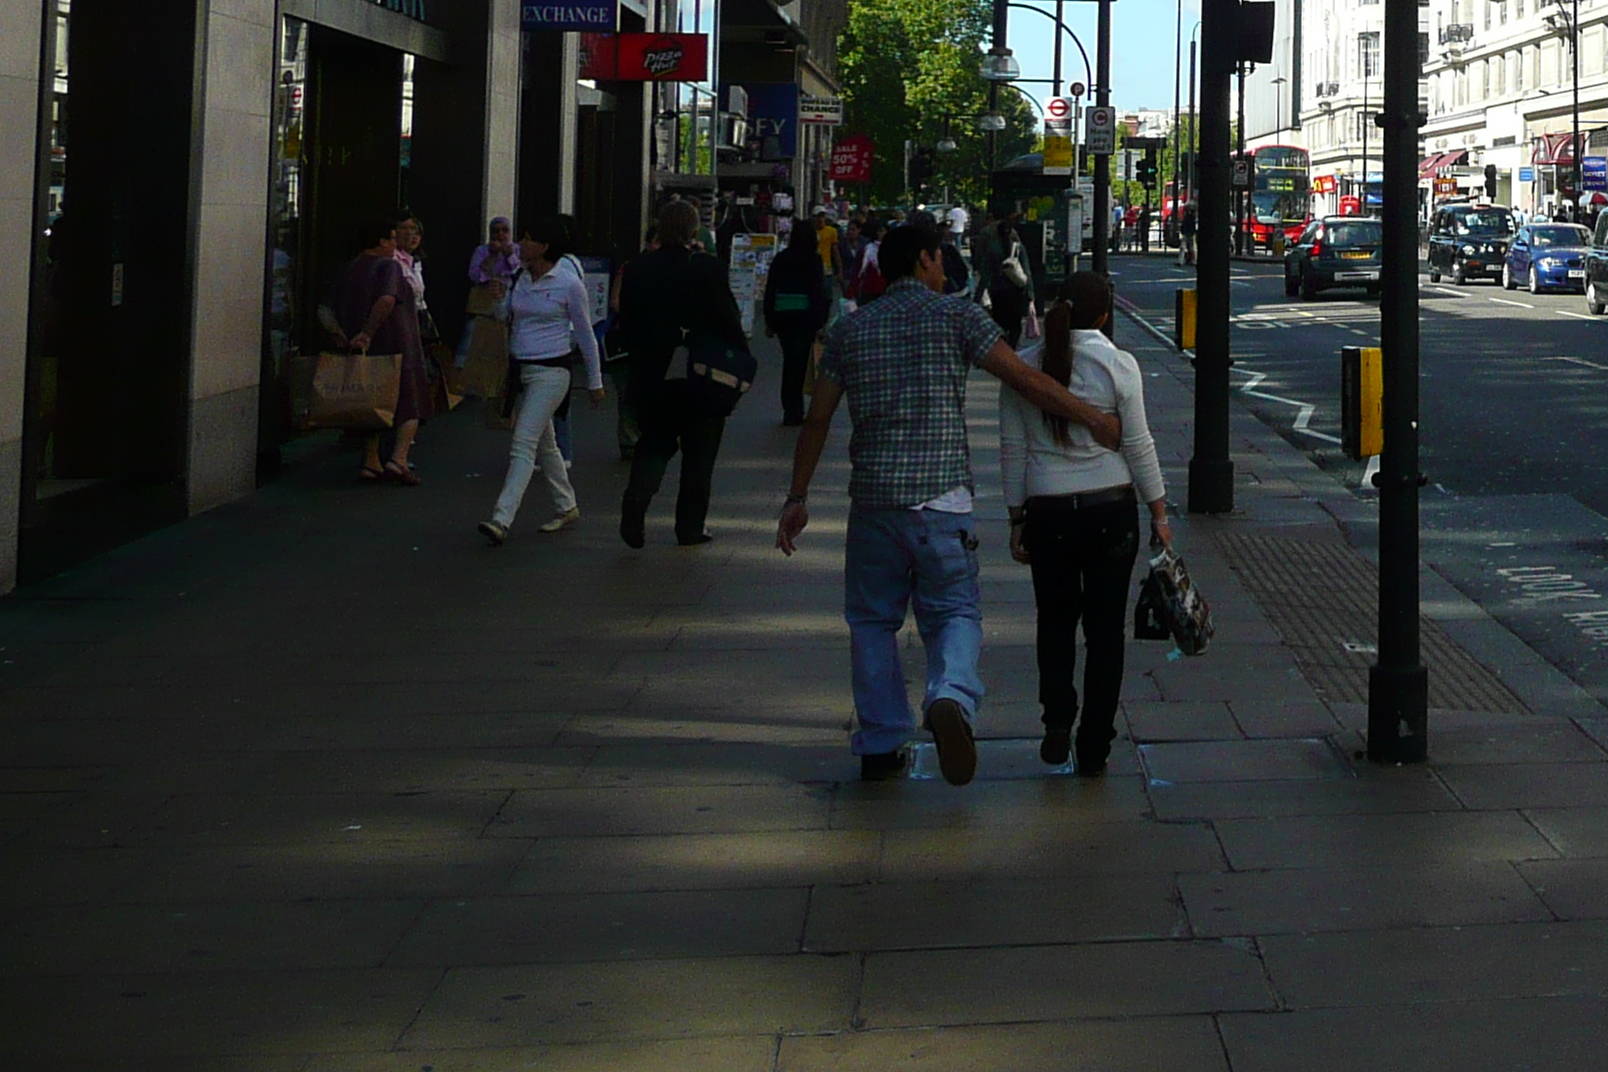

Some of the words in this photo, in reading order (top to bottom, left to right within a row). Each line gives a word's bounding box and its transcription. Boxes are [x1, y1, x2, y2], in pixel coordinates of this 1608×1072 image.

[522, 5, 610, 24] EXCHANGE
[643, 49, 683, 69] Pizza
[650, 58, 678, 73] Hut
[832, 153, 858, 165] 50%
[834, 165, 855, 175] OFF
[1496, 566, 1602, 608] LOOK
